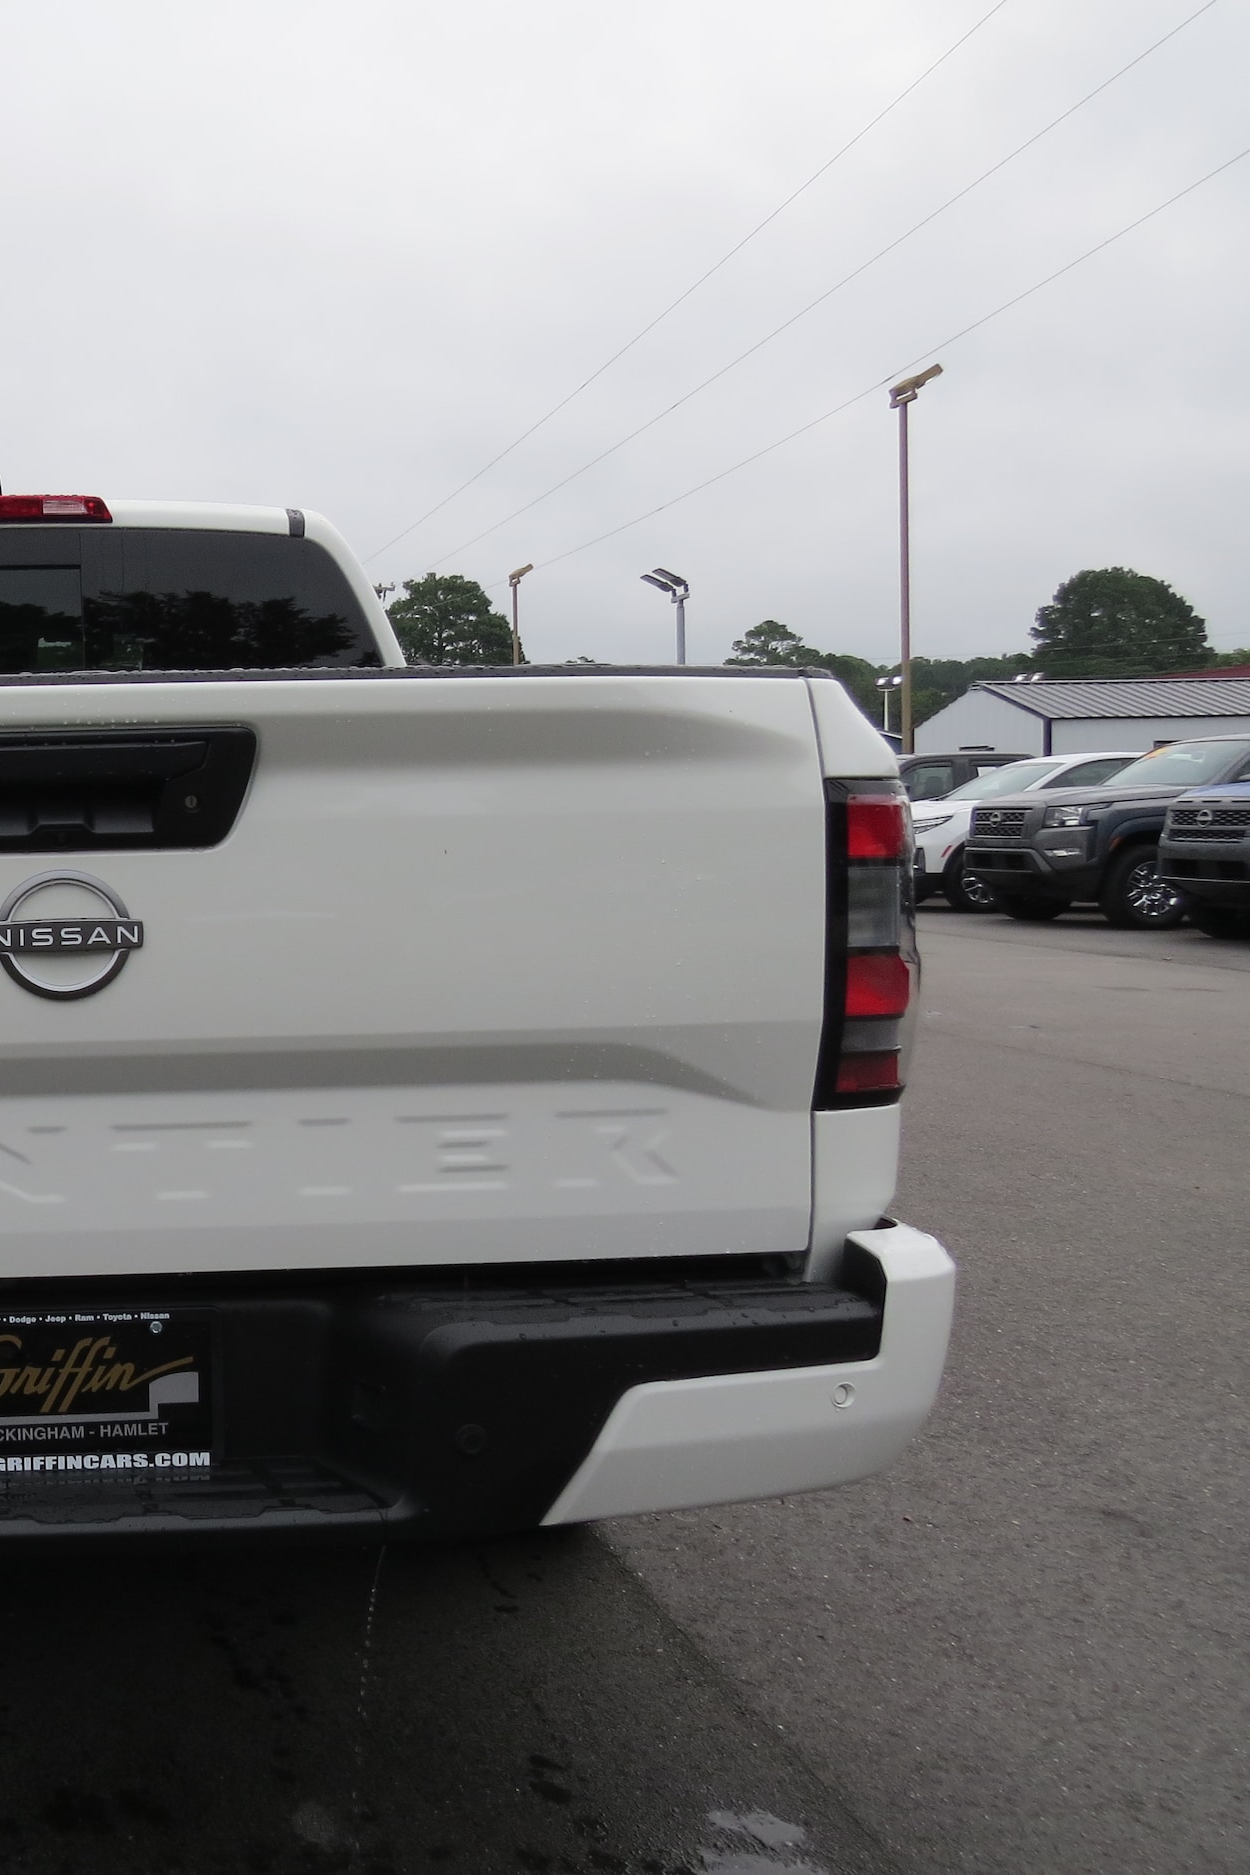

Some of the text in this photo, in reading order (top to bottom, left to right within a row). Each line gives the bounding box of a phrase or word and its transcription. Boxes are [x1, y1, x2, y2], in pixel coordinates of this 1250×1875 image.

[9, 1315, 37, 1325] Dodge
[45, 1315, 67, 1324] Jeep
[74, 1313, 95, 1322] Ram
[102, 1313, 132, 1322] Toyota
[140, 1311, 170, 1320] Nissan
[100, 1422, 169, 1438] HAMLET
